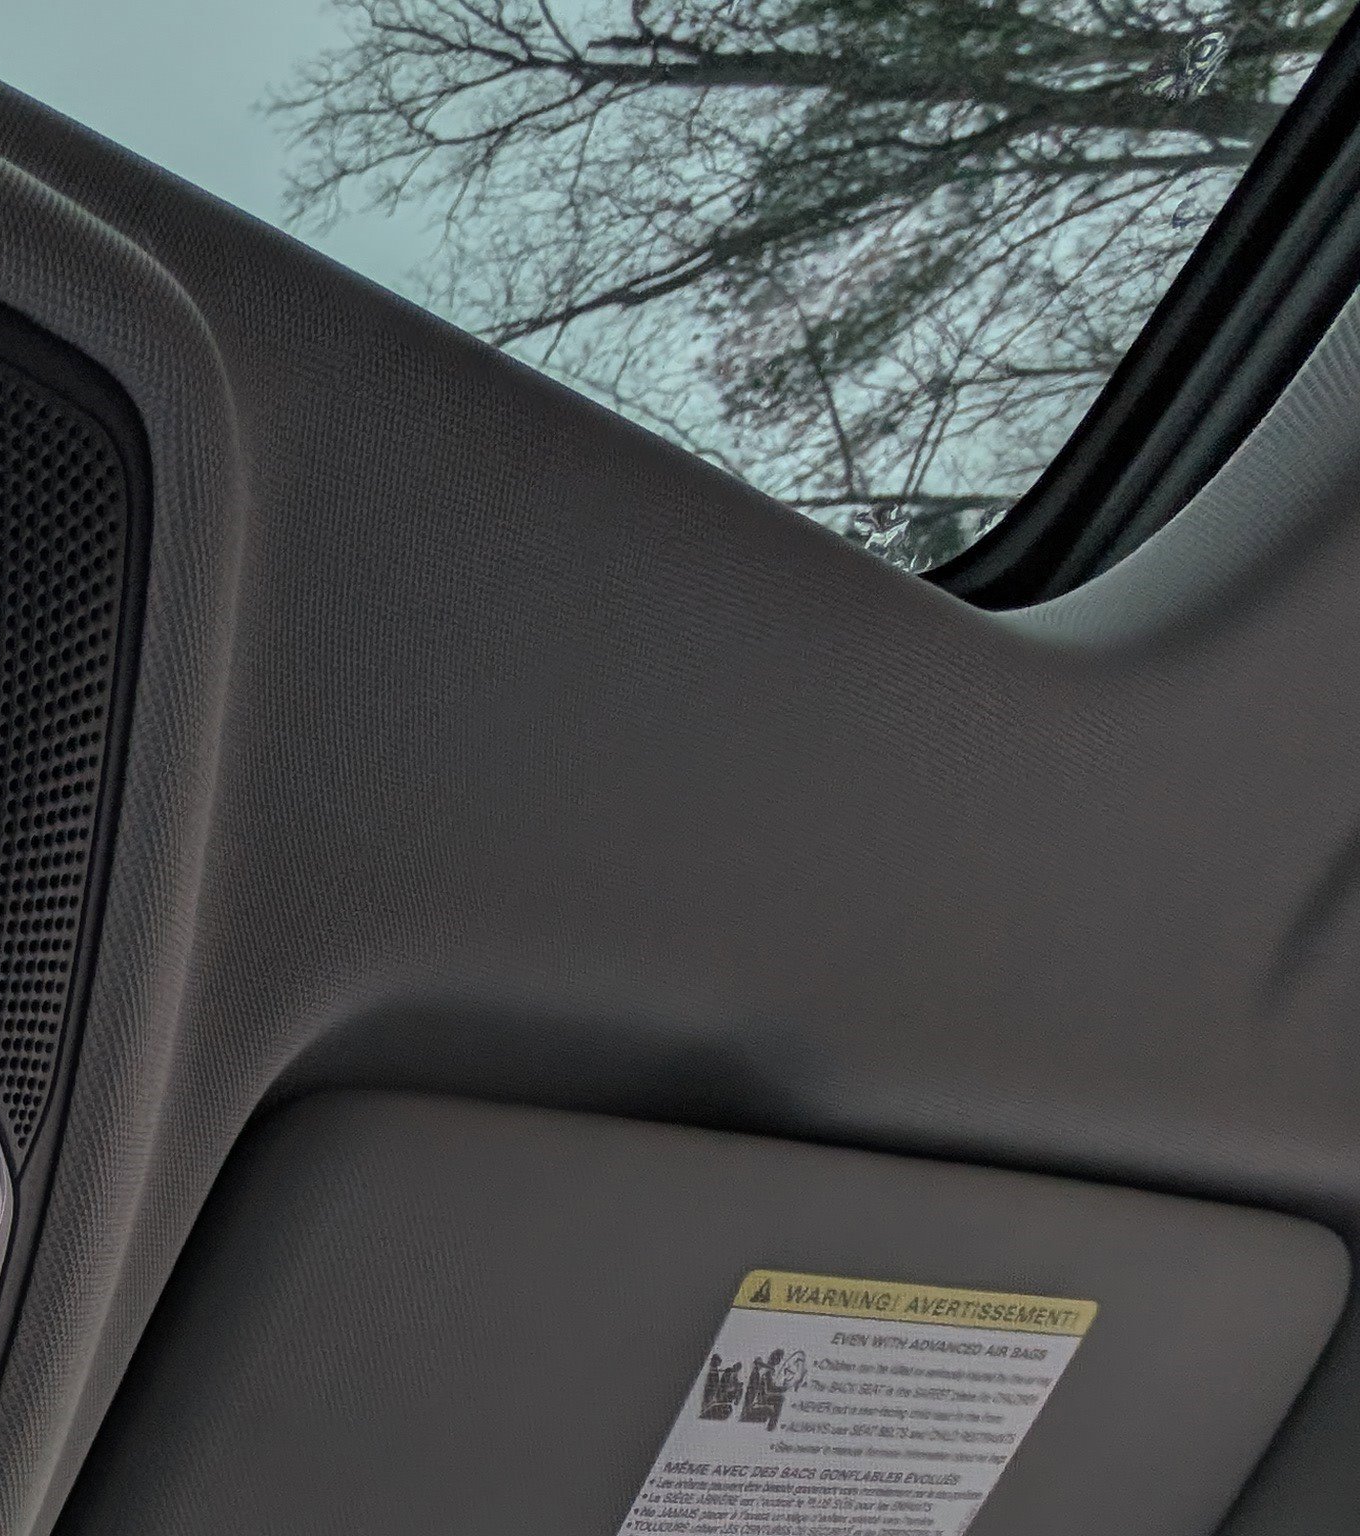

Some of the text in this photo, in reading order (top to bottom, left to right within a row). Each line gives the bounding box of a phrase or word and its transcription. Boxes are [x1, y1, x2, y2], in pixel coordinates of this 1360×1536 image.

[786, 1283, 1080, 1328] WARNING! AVERTISSEMENT!
[832, 1332, 870, 1347] EVEN
[872, 1334, 909, 1350] WITH
[909, 1338, 983, 1356] ADVANCED
[984, 1345, 1009, 1358] AIR
[711, 1464, 750, 1477] AVEC
[750, 1465, 780, 1478] DES
